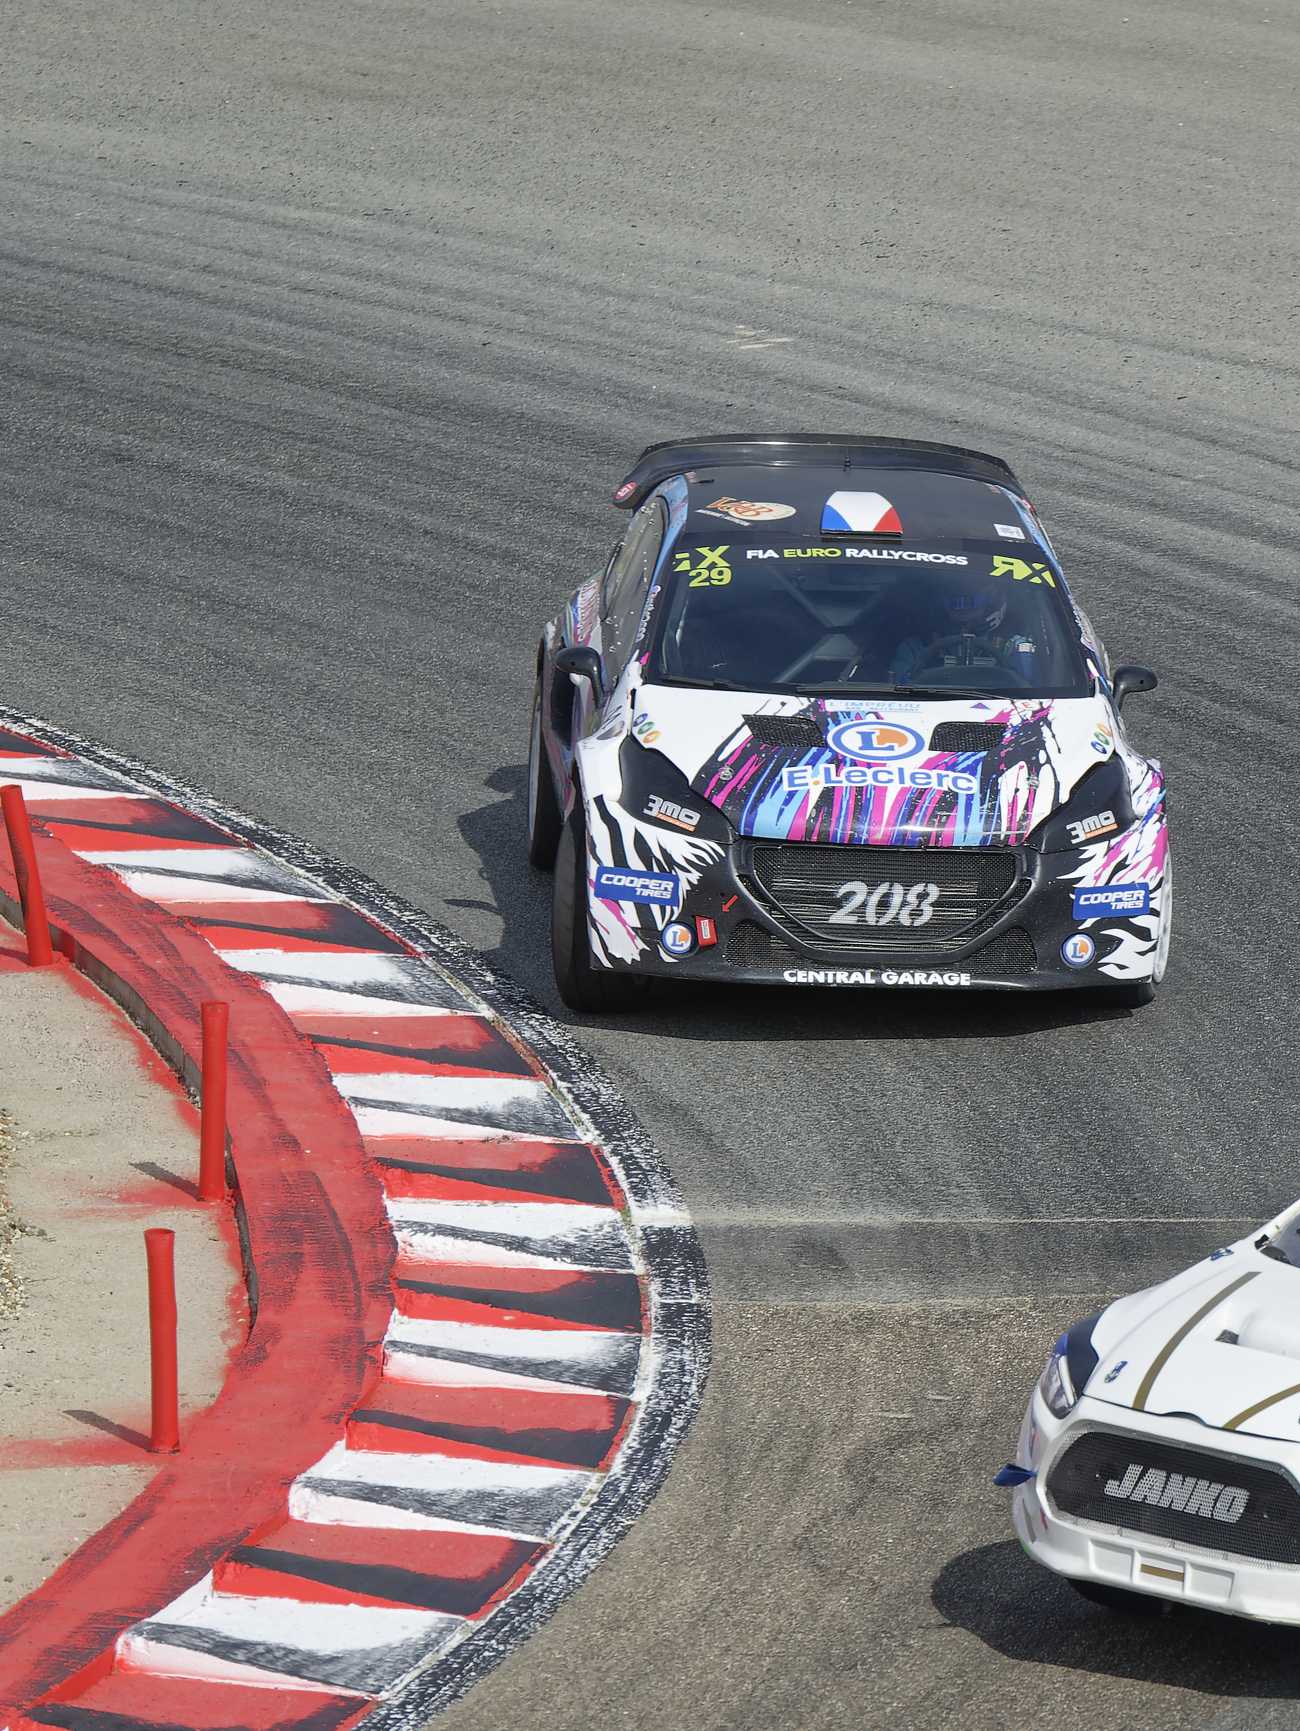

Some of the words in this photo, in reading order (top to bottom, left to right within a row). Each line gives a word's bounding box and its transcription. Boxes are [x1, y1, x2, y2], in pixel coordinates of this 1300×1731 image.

[746, 549, 779, 560] FIA
[783, 548, 841, 558] EURO
[845, 548, 969, 566] RALLYCROSS
[689, 567, 732, 588] 29
[600, 873, 674, 892] COOPER
[635, 887, 672, 899] TIRES
[1079, 889, 1146, 905] COOPER
[828, 880, 940, 927] 208
[1111, 900, 1144, 910] TIRES
[783, 969, 876, 985] CENTRAL
[881, 971, 971, 986] GARAGE
[1104, 1463, 1250, 1524] JANKO
